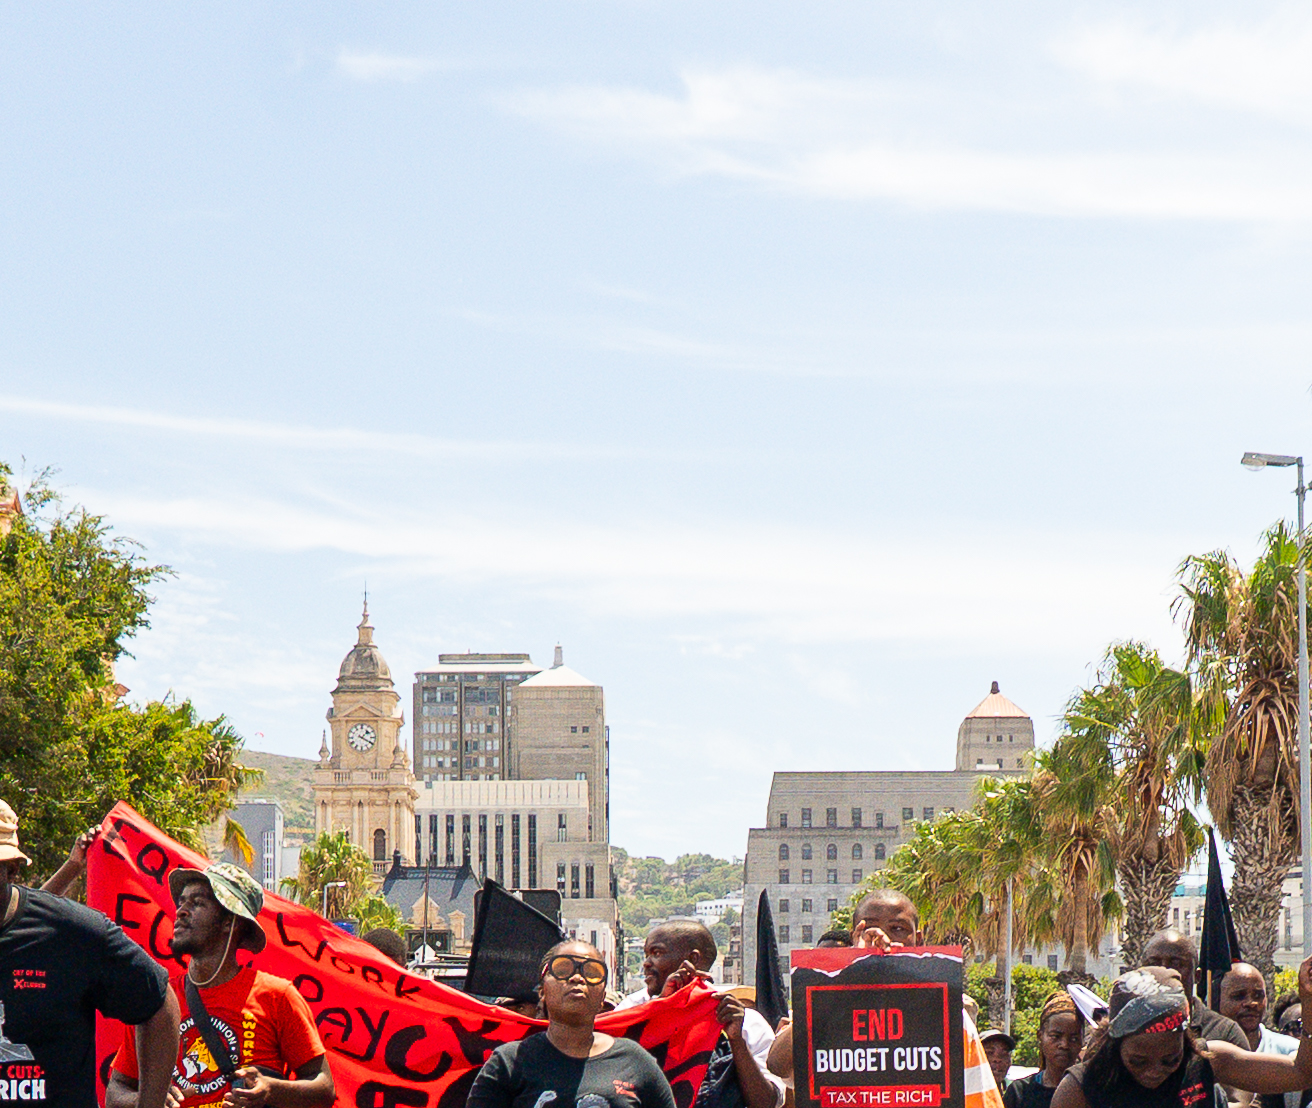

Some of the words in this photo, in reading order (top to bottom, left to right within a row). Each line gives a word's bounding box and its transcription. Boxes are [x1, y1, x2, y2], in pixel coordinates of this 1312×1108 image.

[276, 912, 421, 999] WORK
[852, 1008, 904, 1042] END
[816, 1048, 889, 1073] BUDGET
[893, 1046, 942, 1071] CUTS
[826, 1092, 857, 1104] TAX
[860, 1091, 891, 1104] THE
[894, 1090, 933, 1103] RICH
